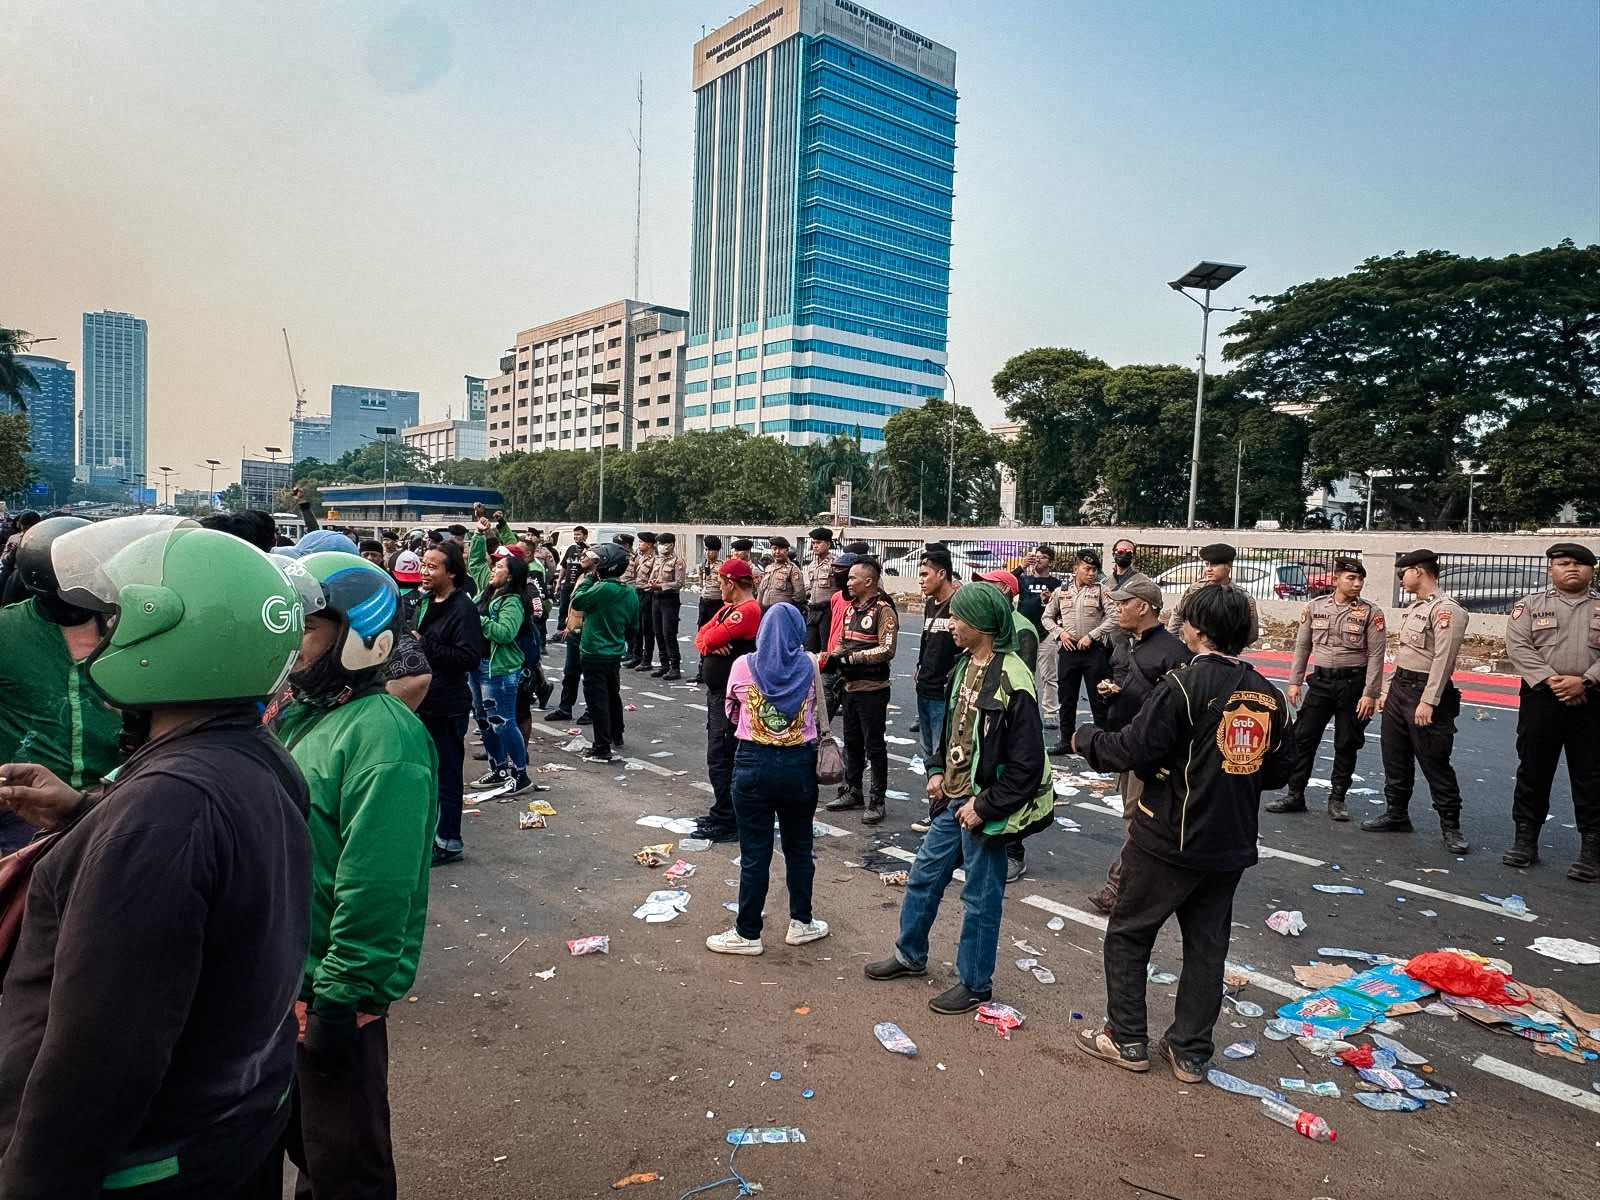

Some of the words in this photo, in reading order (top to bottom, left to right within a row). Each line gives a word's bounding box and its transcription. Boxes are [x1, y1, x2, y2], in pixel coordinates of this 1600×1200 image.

[706, 43, 723, 60] BADAN
[753, 6, 784, 32] KEUANGAN
[716, 41, 742, 64] REPUBLIK
[741, 25, 771, 49] INDONESIA
[835, 0, 859, 16] BADAN
[860, 6, 897, 34] PEMERIKSA
[899, 28, 933, 51] KEUANGAN
[769, 718, 787, 726] Grab
[1232, 717, 1254, 728] Grab
